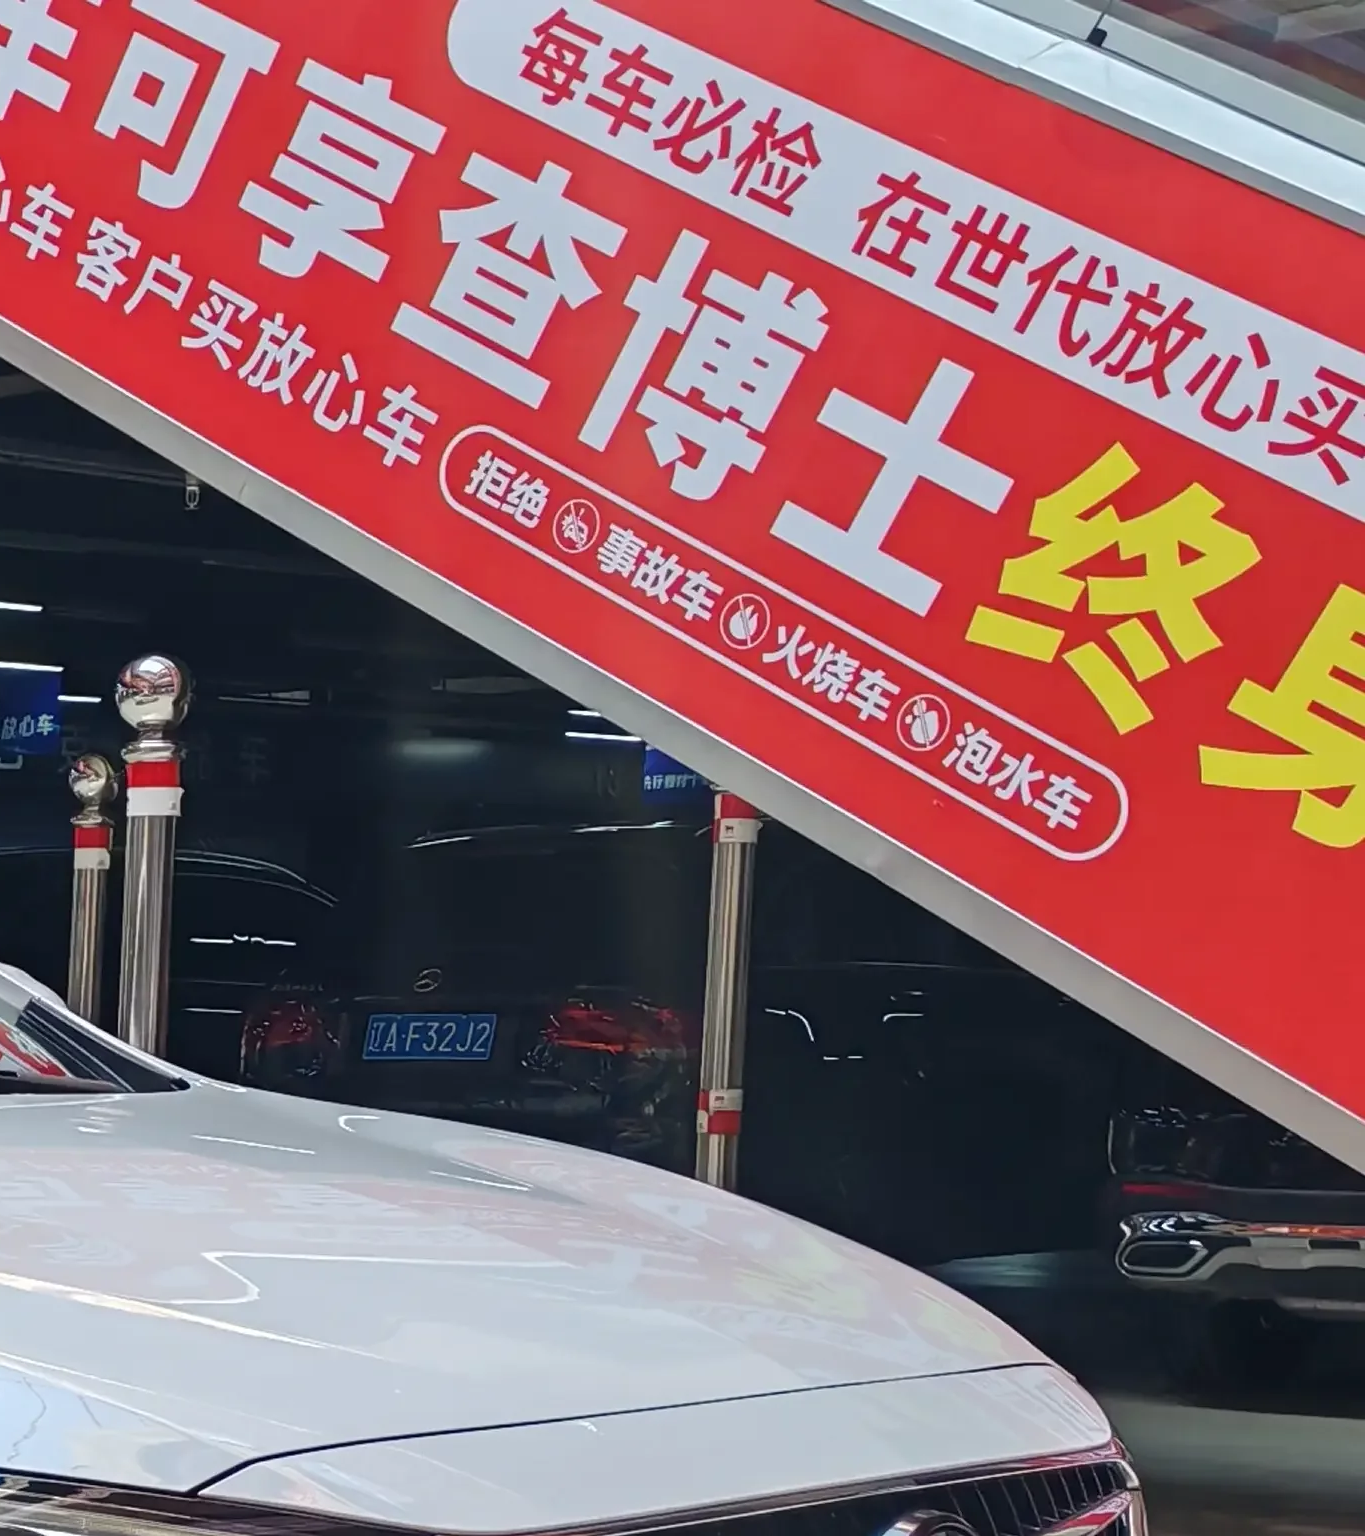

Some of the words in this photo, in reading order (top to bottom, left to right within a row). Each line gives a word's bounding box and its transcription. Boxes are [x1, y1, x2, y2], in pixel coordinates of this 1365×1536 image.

[75, 216, 440, 468] 客户买放心车
[518, 7, 822, 218] 每车必检
[851, 171, 1365, 486] 在世代放心买
[462, 450, 550, 529] 拒绝
[596, 523, 725, 621] 事故车
[762, 624, 901, 721] 火烧车
[941, 722, 1093, 831] 泡水车
